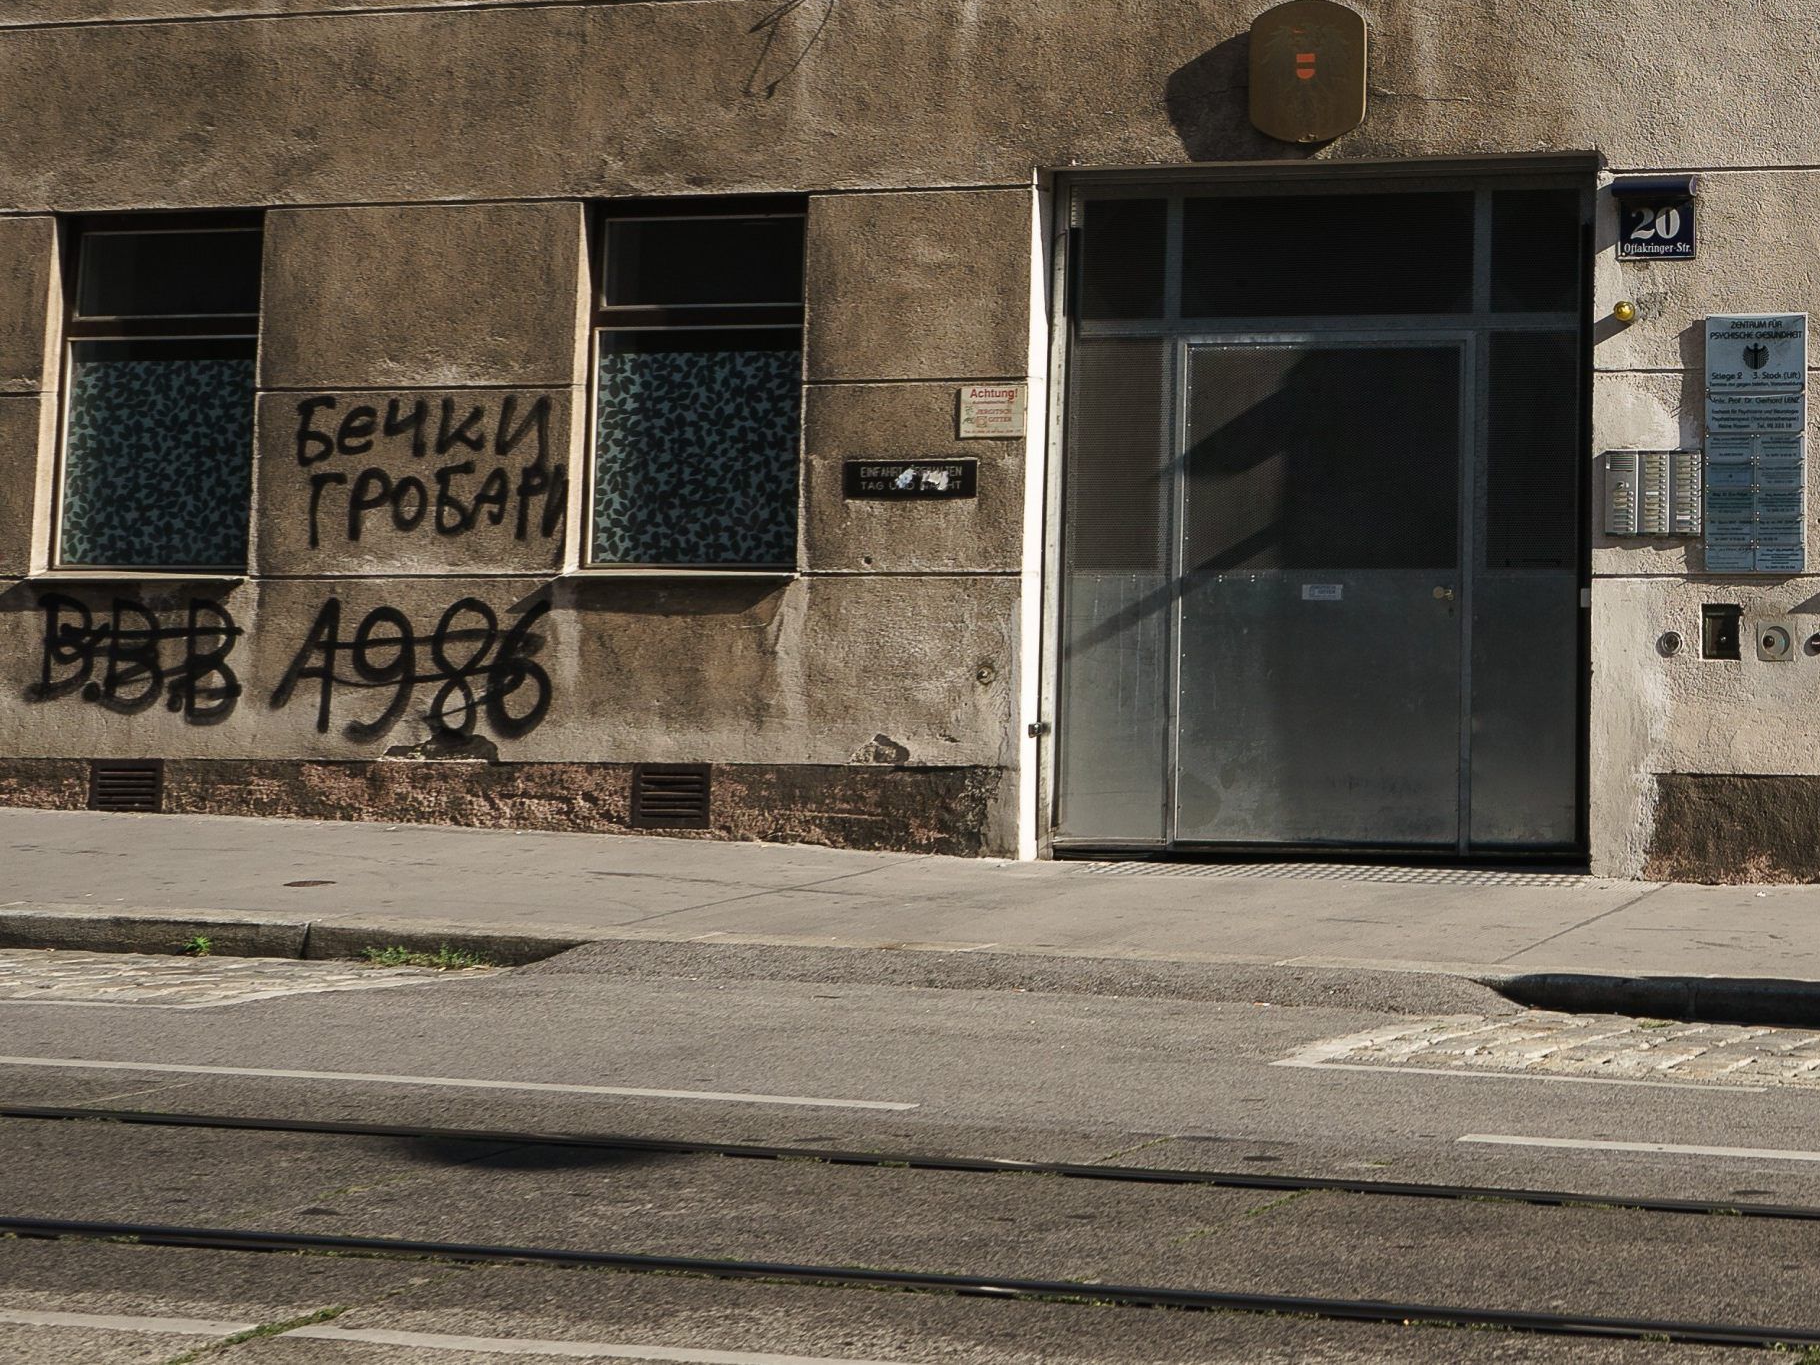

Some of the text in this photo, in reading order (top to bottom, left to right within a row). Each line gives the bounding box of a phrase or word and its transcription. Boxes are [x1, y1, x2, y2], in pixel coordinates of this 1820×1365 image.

[1630, 207, 1680, 240] 20
[1730, 319, 1783, 329] ZENTRUM FÜR
[1710, 330, 1803, 340] PSYCHISCHE GESUNDHEIT
[1711, 372, 1736, 381] Stiege
[1737, 372, 1743, 380] 2
[1762, 372, 1781, 380] Stock
[970, 388, 1018, 402] Achtung!
[860, 466, 904, 478] EINFAHRT
[861, 481, 885, 491] TAG
[889, 481, 916, 491] UD
